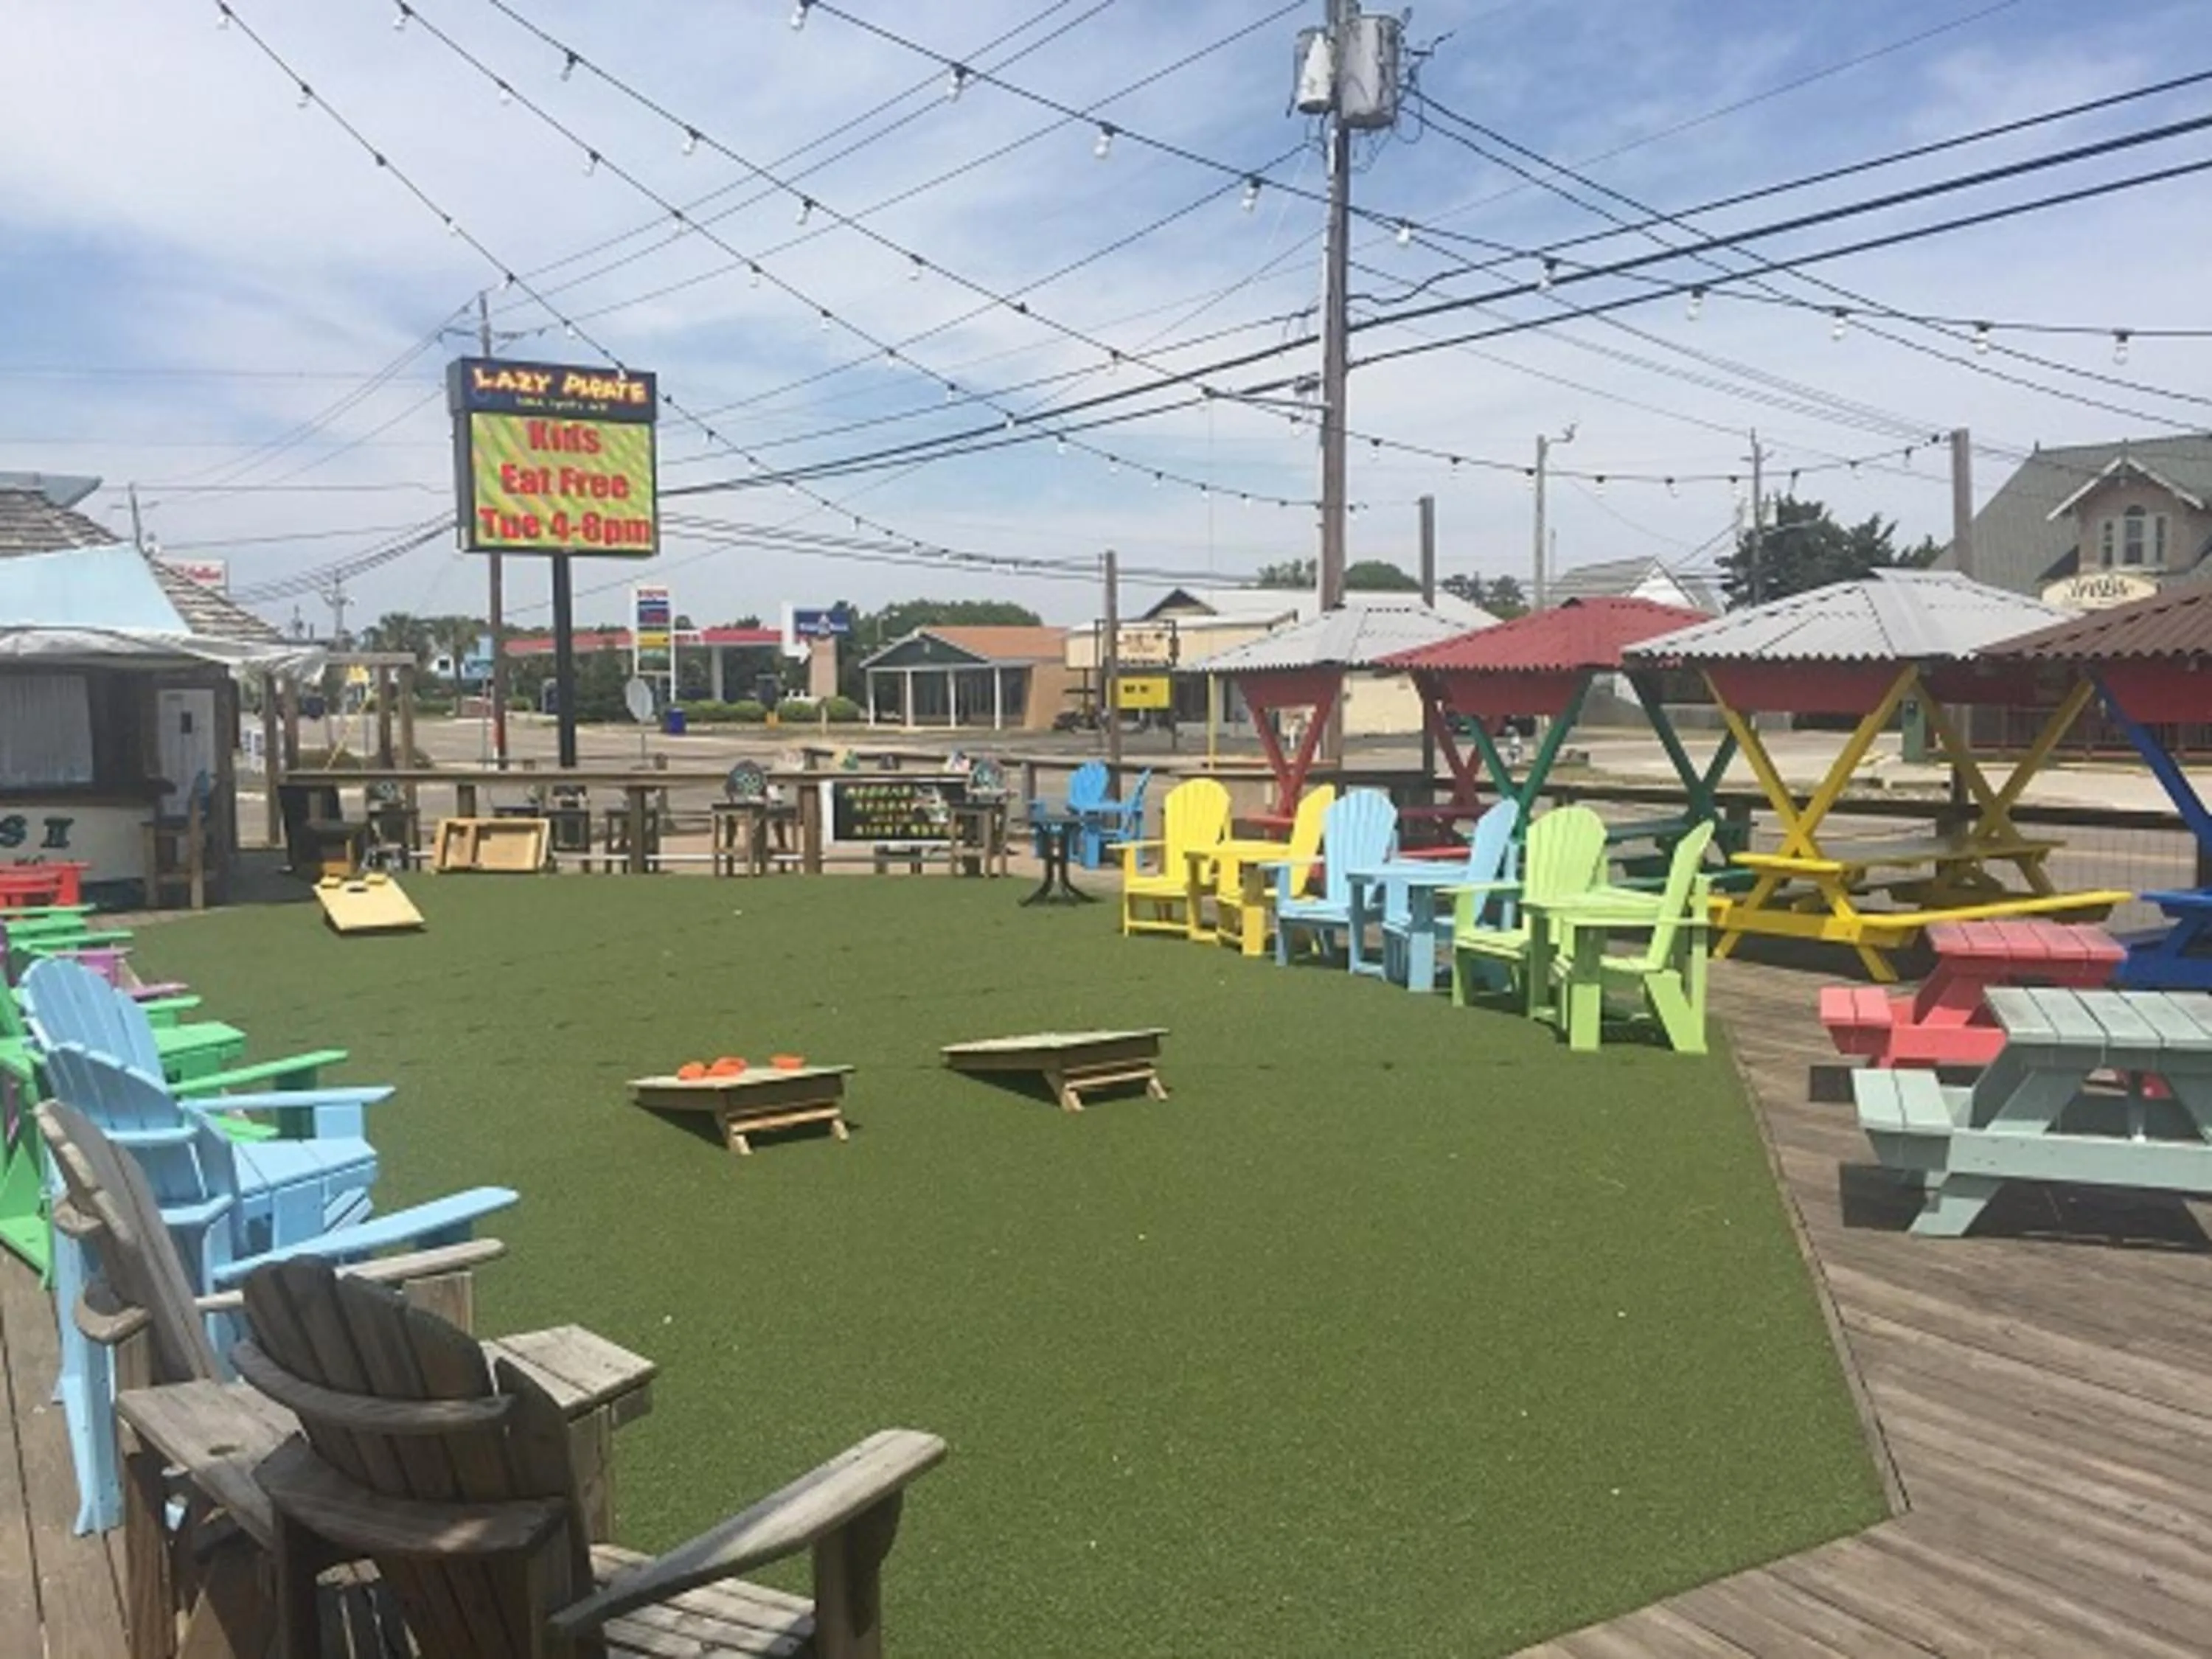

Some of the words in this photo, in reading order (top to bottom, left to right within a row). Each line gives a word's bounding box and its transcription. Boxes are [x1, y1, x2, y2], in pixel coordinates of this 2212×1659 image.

[473, 367, 552, 393] LAZY
[562, 371, 647, 403] PIRATE
[526, 420, 602, 454] Kids
[501, 463, 552, 495] Eat
[559, 467, 630, 499] Free
[478, 507, 540, 539] Tue
